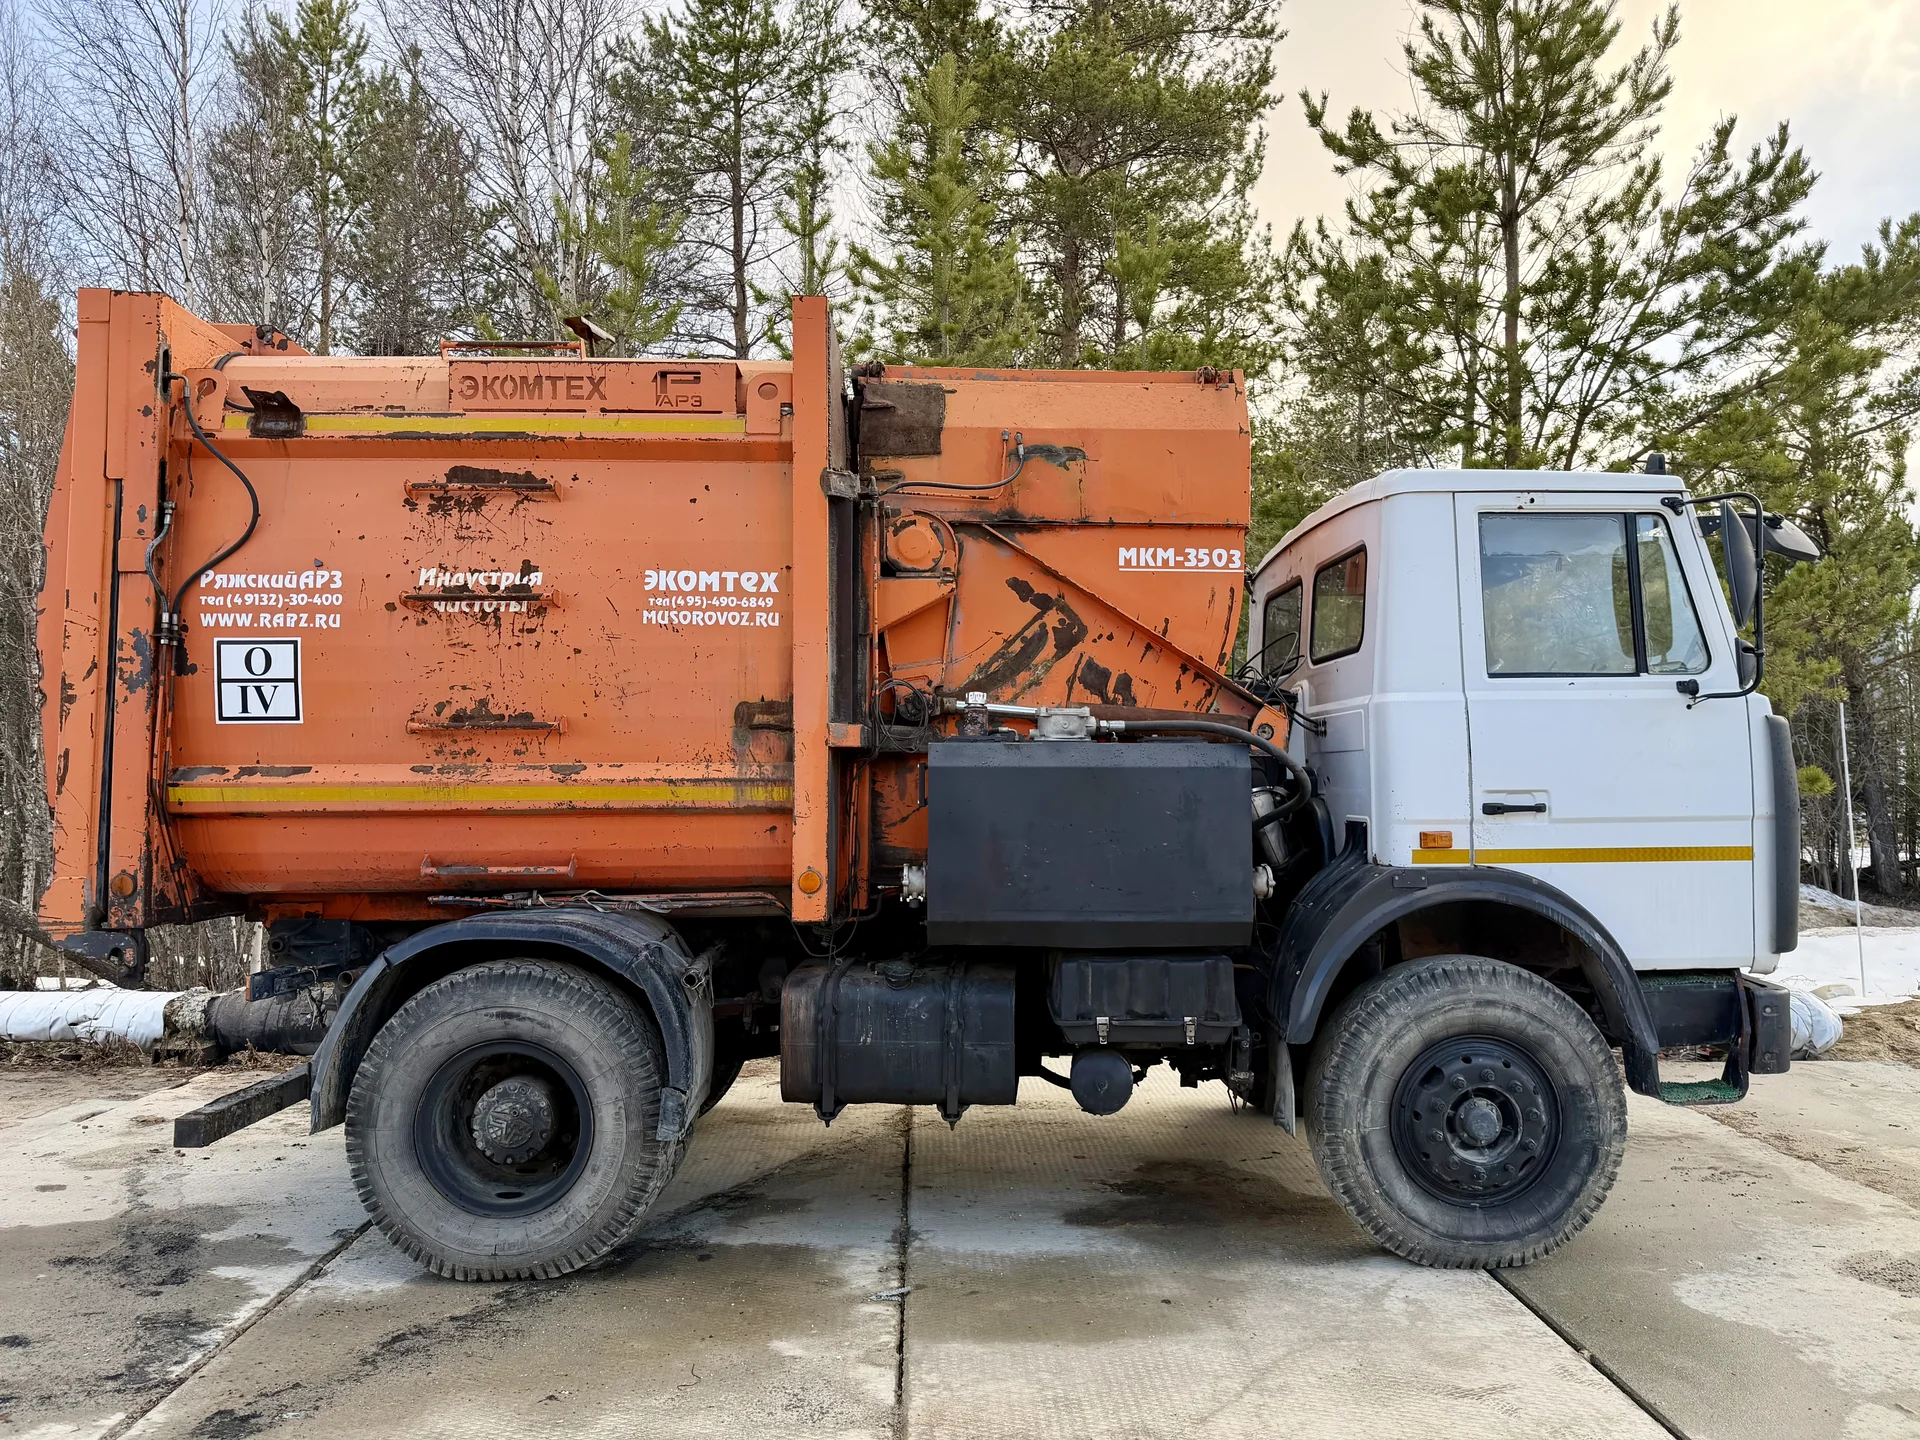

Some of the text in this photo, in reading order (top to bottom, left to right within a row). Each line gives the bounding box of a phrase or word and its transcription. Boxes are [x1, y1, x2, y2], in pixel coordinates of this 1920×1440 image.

[458, 374, 608, 401] ЭКОМТЕХ
[1118, 547, 1242, 569] МКМ-3503
[642, 609, 780, 628] MUSOROVOZ.RU
[237, 685, 279, 714] IV
